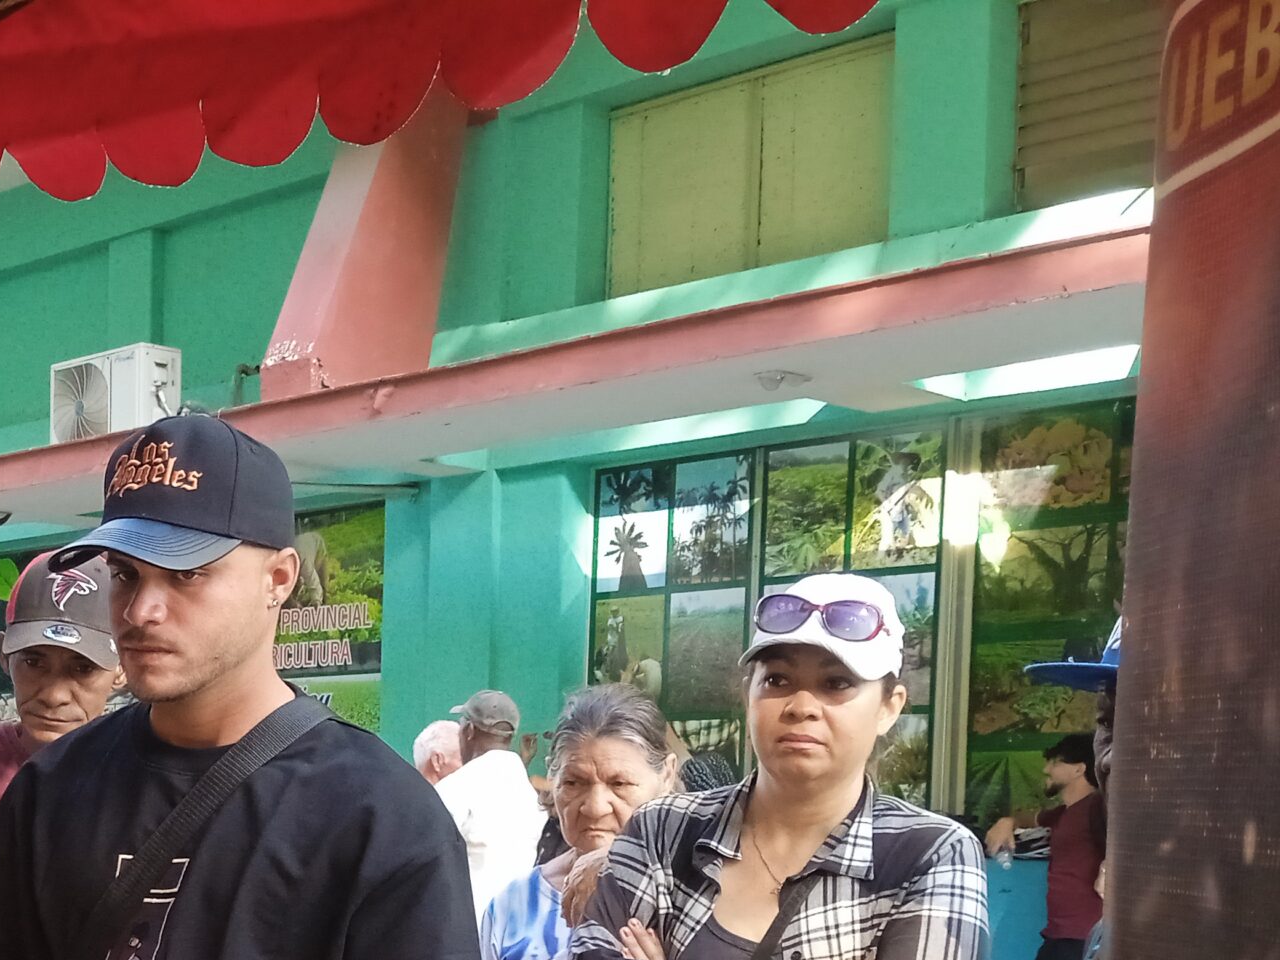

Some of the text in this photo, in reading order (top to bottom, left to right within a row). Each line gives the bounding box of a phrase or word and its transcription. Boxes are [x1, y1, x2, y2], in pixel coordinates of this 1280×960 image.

[129, 434, 175, 463] Los
[106, 454, 203, 498] Angeles
[280, 602, 373, 635] PROVINCIAL
